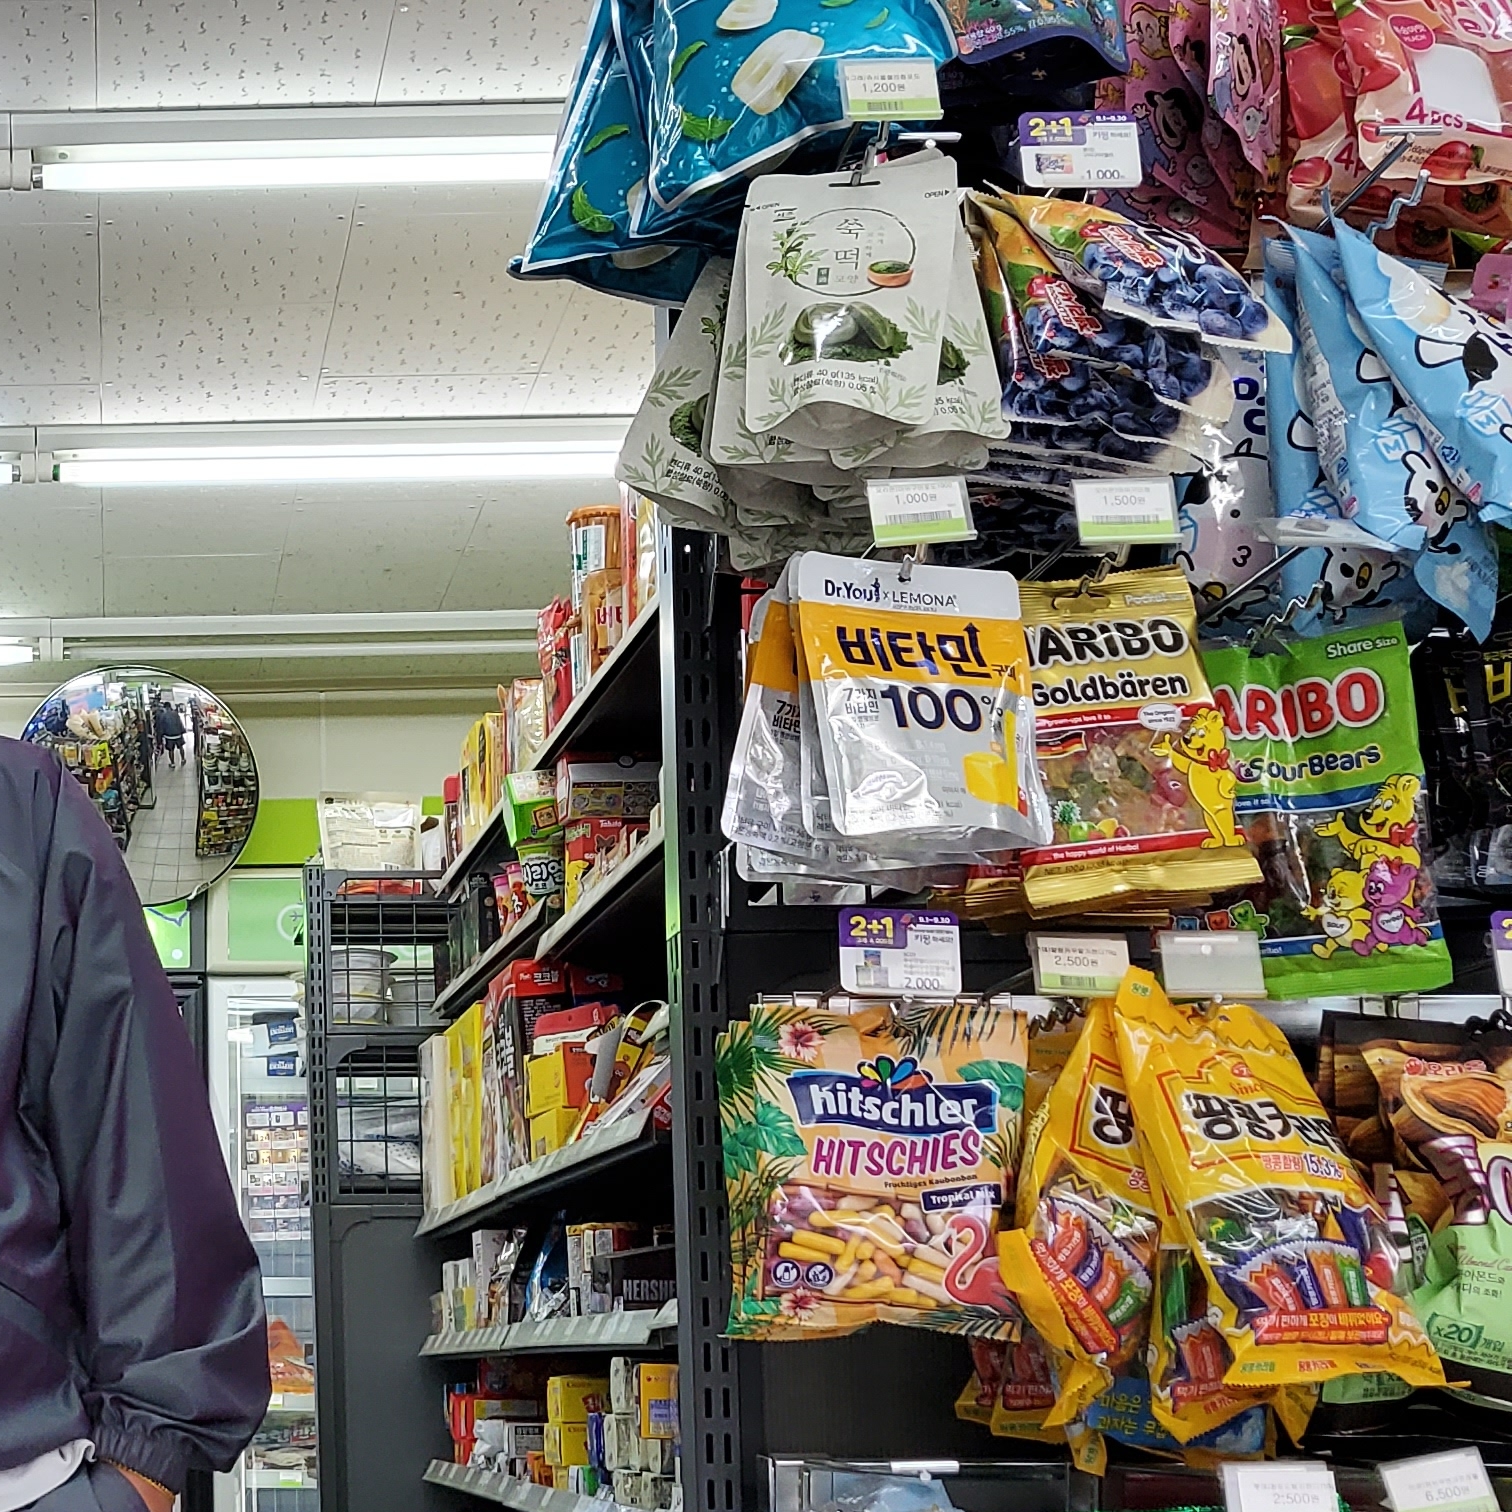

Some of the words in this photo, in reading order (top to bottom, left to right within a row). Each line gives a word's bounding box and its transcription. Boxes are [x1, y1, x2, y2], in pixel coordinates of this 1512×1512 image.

[862, 82, 906, 93] 1,200원
[1028, 116, 1074, 137] 2+1
[924, 190, 944, 199] OPEN
[894, 492, 937, 504] 1,000원
[1102, 494, 1146, 507] 1,500원
[892, 591, 954, 607] LEMONA
[836, 622, 993, 680] 비타민
[1326, 640, 1373, 659] Share
[1375, 636, 1398, 648] Size
[849, 915, 894, 938] 2+1
[1054, 955, 1099, 968] 2,500원
[809, 1083, 978, 1128] hitschler
[812, 1128, 981, 1177] HITSCHIES
[930, 1190, 974, 1205] Tropical
[1425, 1485, 1470, 1503] 6,500원
